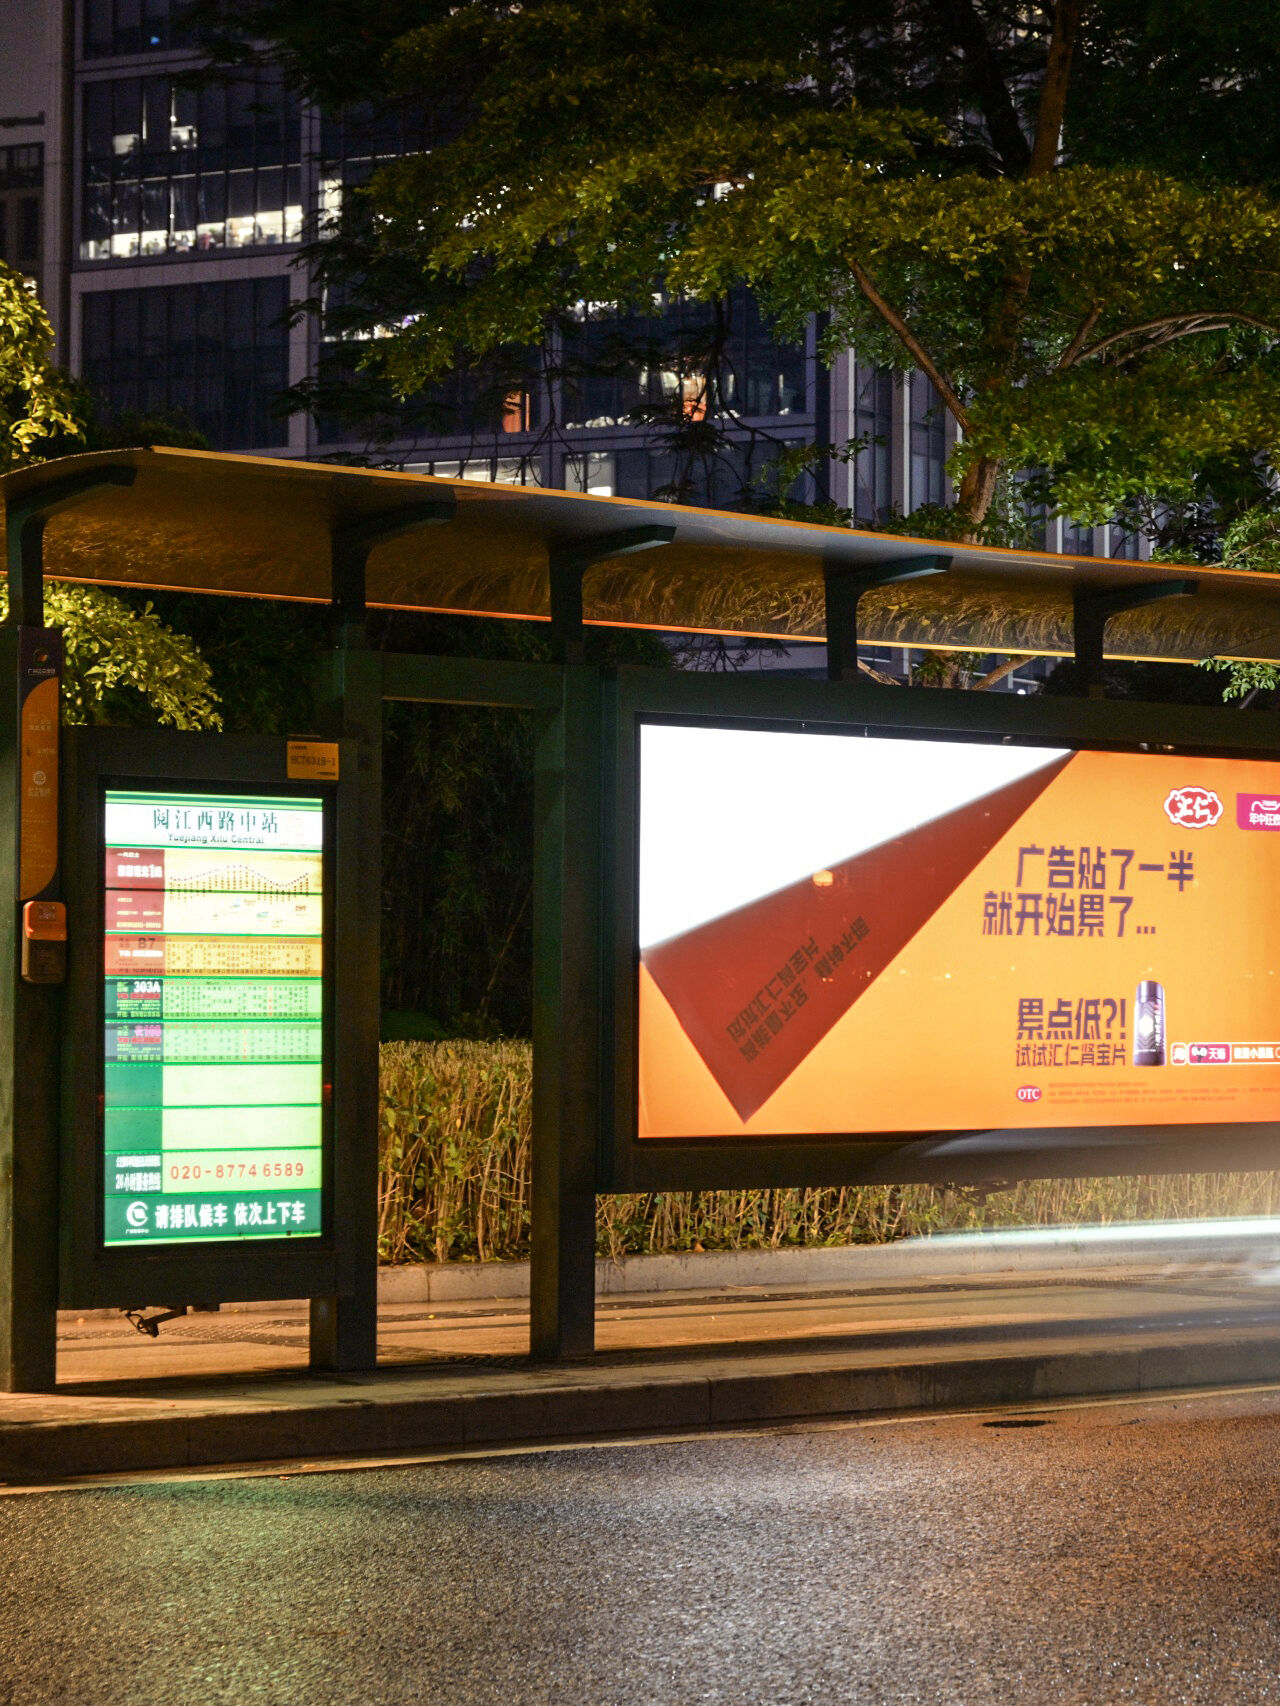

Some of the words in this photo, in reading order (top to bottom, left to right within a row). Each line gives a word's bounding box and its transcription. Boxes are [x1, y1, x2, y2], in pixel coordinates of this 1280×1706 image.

[153, 808, 278, 833] 阅江西路中站
[168, 833, 208, 844] Yuejiang
[231, 834, 264, 844] Central
[1016, 845, 1195, 892] 广告贴了一半
[133, 981, 161, 993] 303A
[1016, 1043, 1127, 1067] 试试汇仁肾宝片
[1018, 1088, 1040, 1100] OTC
[170, 1163, 305, 1180] 020-87746589
[155, 1202, 228, 1229] 请排队候车
[234, 1201, 306, 1226] 依次上下车
